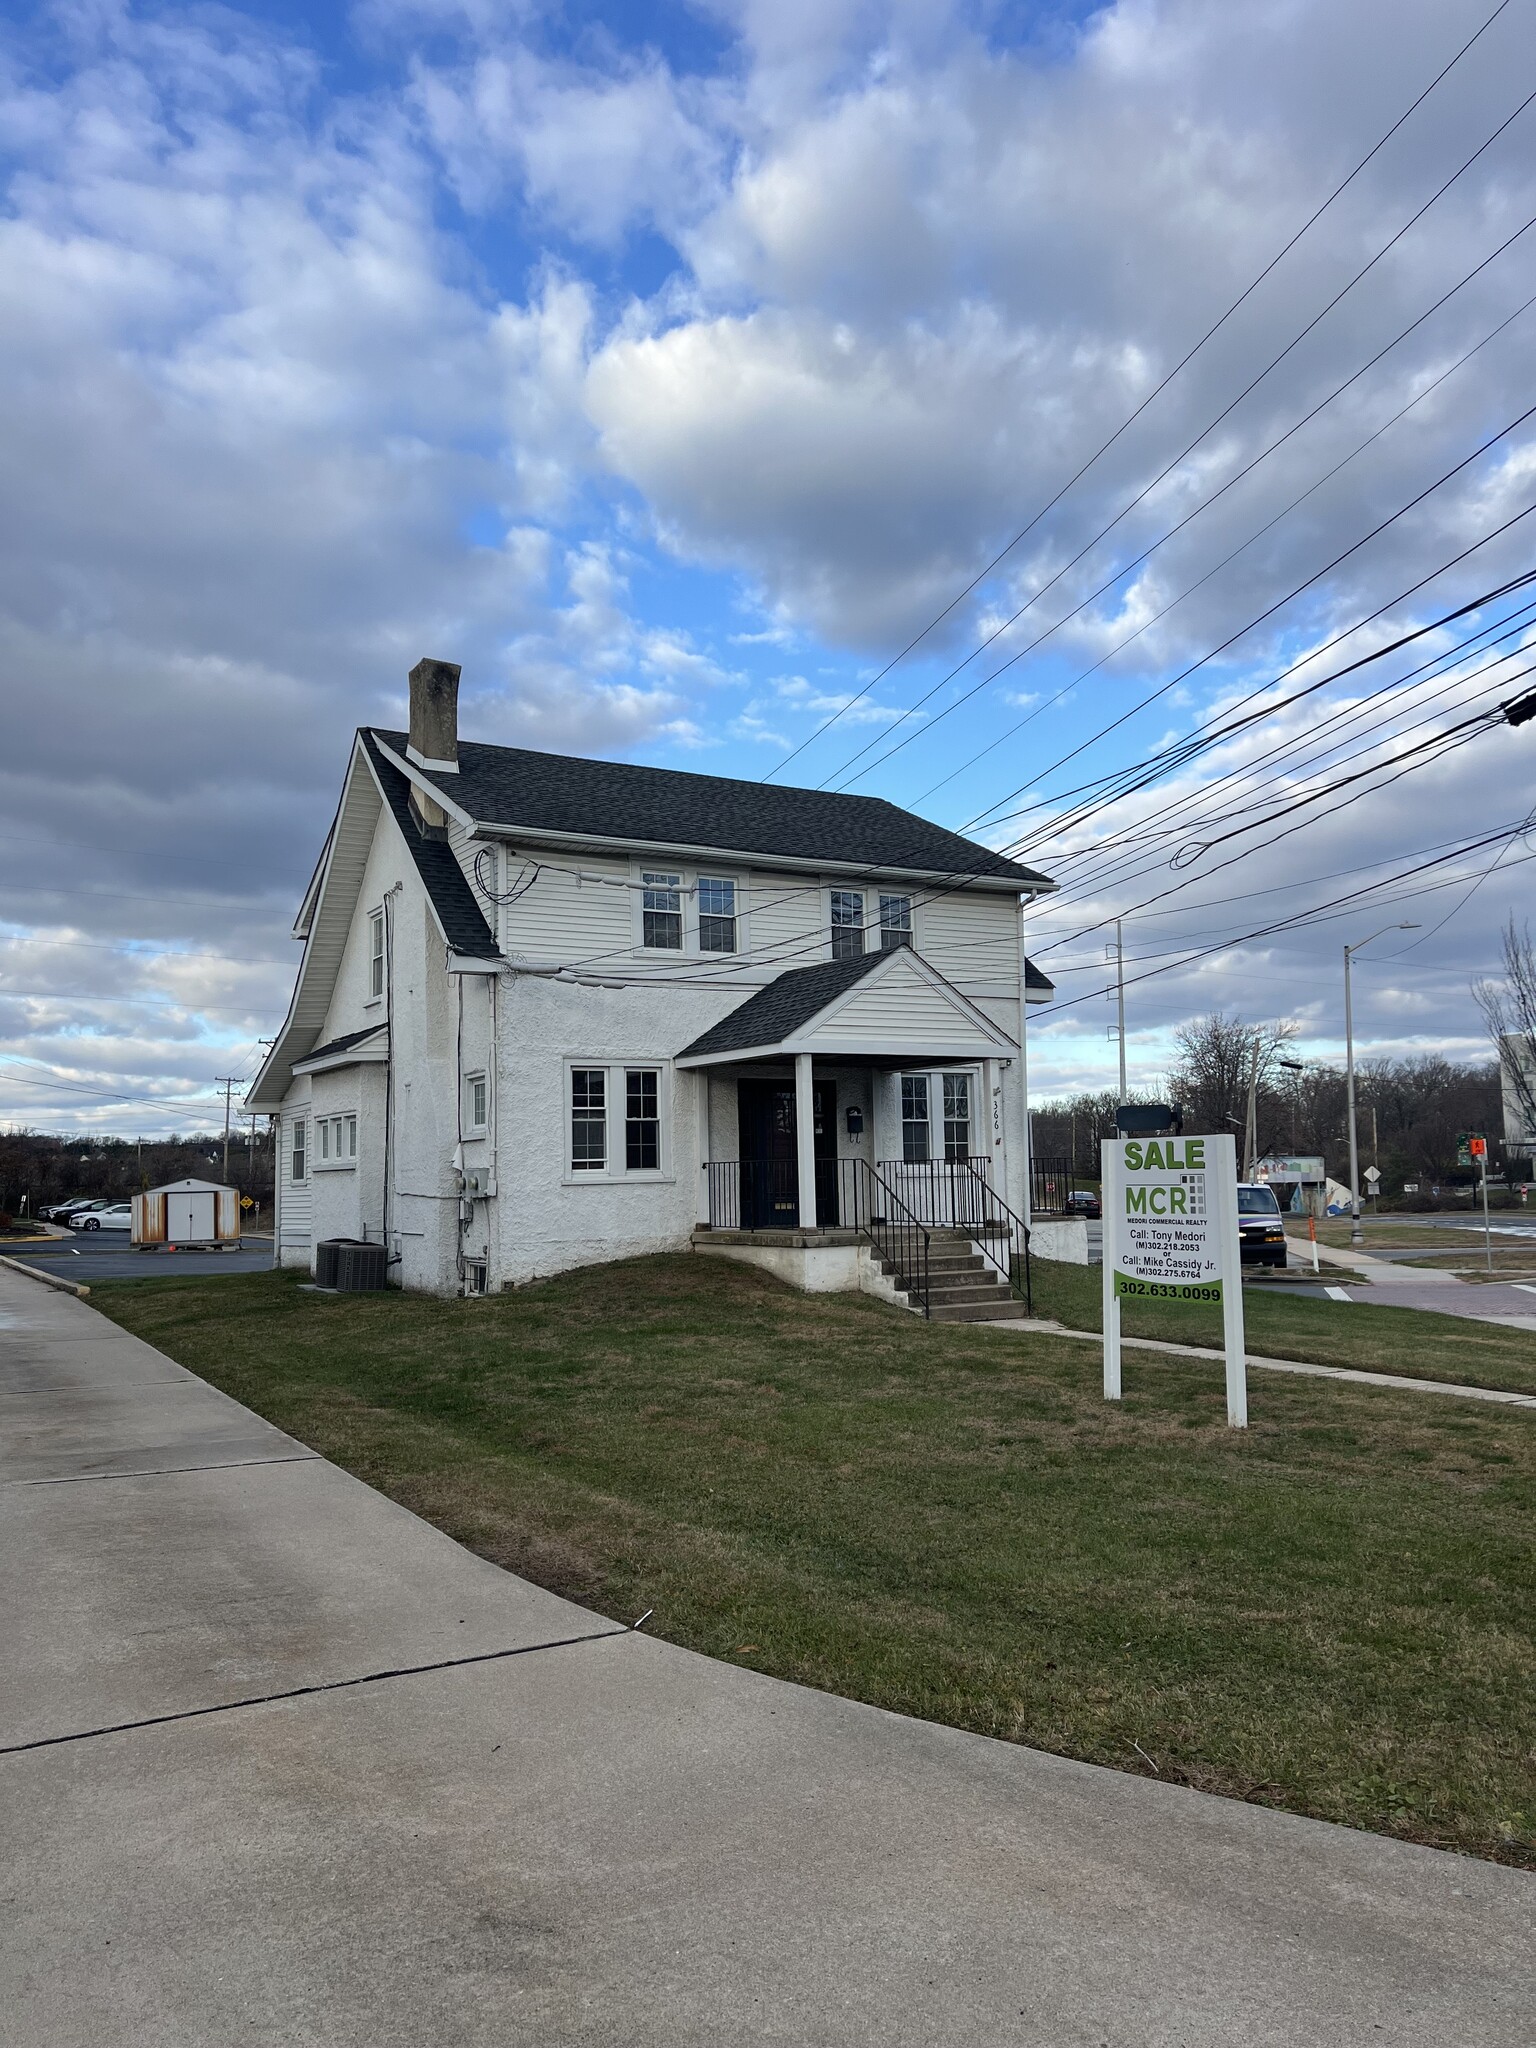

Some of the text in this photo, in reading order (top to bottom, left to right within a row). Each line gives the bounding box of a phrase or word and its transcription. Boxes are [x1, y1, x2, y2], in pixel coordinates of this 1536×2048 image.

[1124, 1140, 1206, 1170] SALE
[1126, 1187, 1188, 1215] MCR
[1130, 1229, 1206, 1242] Call: Tony Medori
[1136, 1241, 1200, 1252] (M)302.218.2053
[1122, 1255, 1216, 1270] Call: Mike Cassidy Jr.
[1136, 1267, 1201, 1279] (M)302.275.6764
[1120, 1282, 1221, 1301] 302.633.0099
